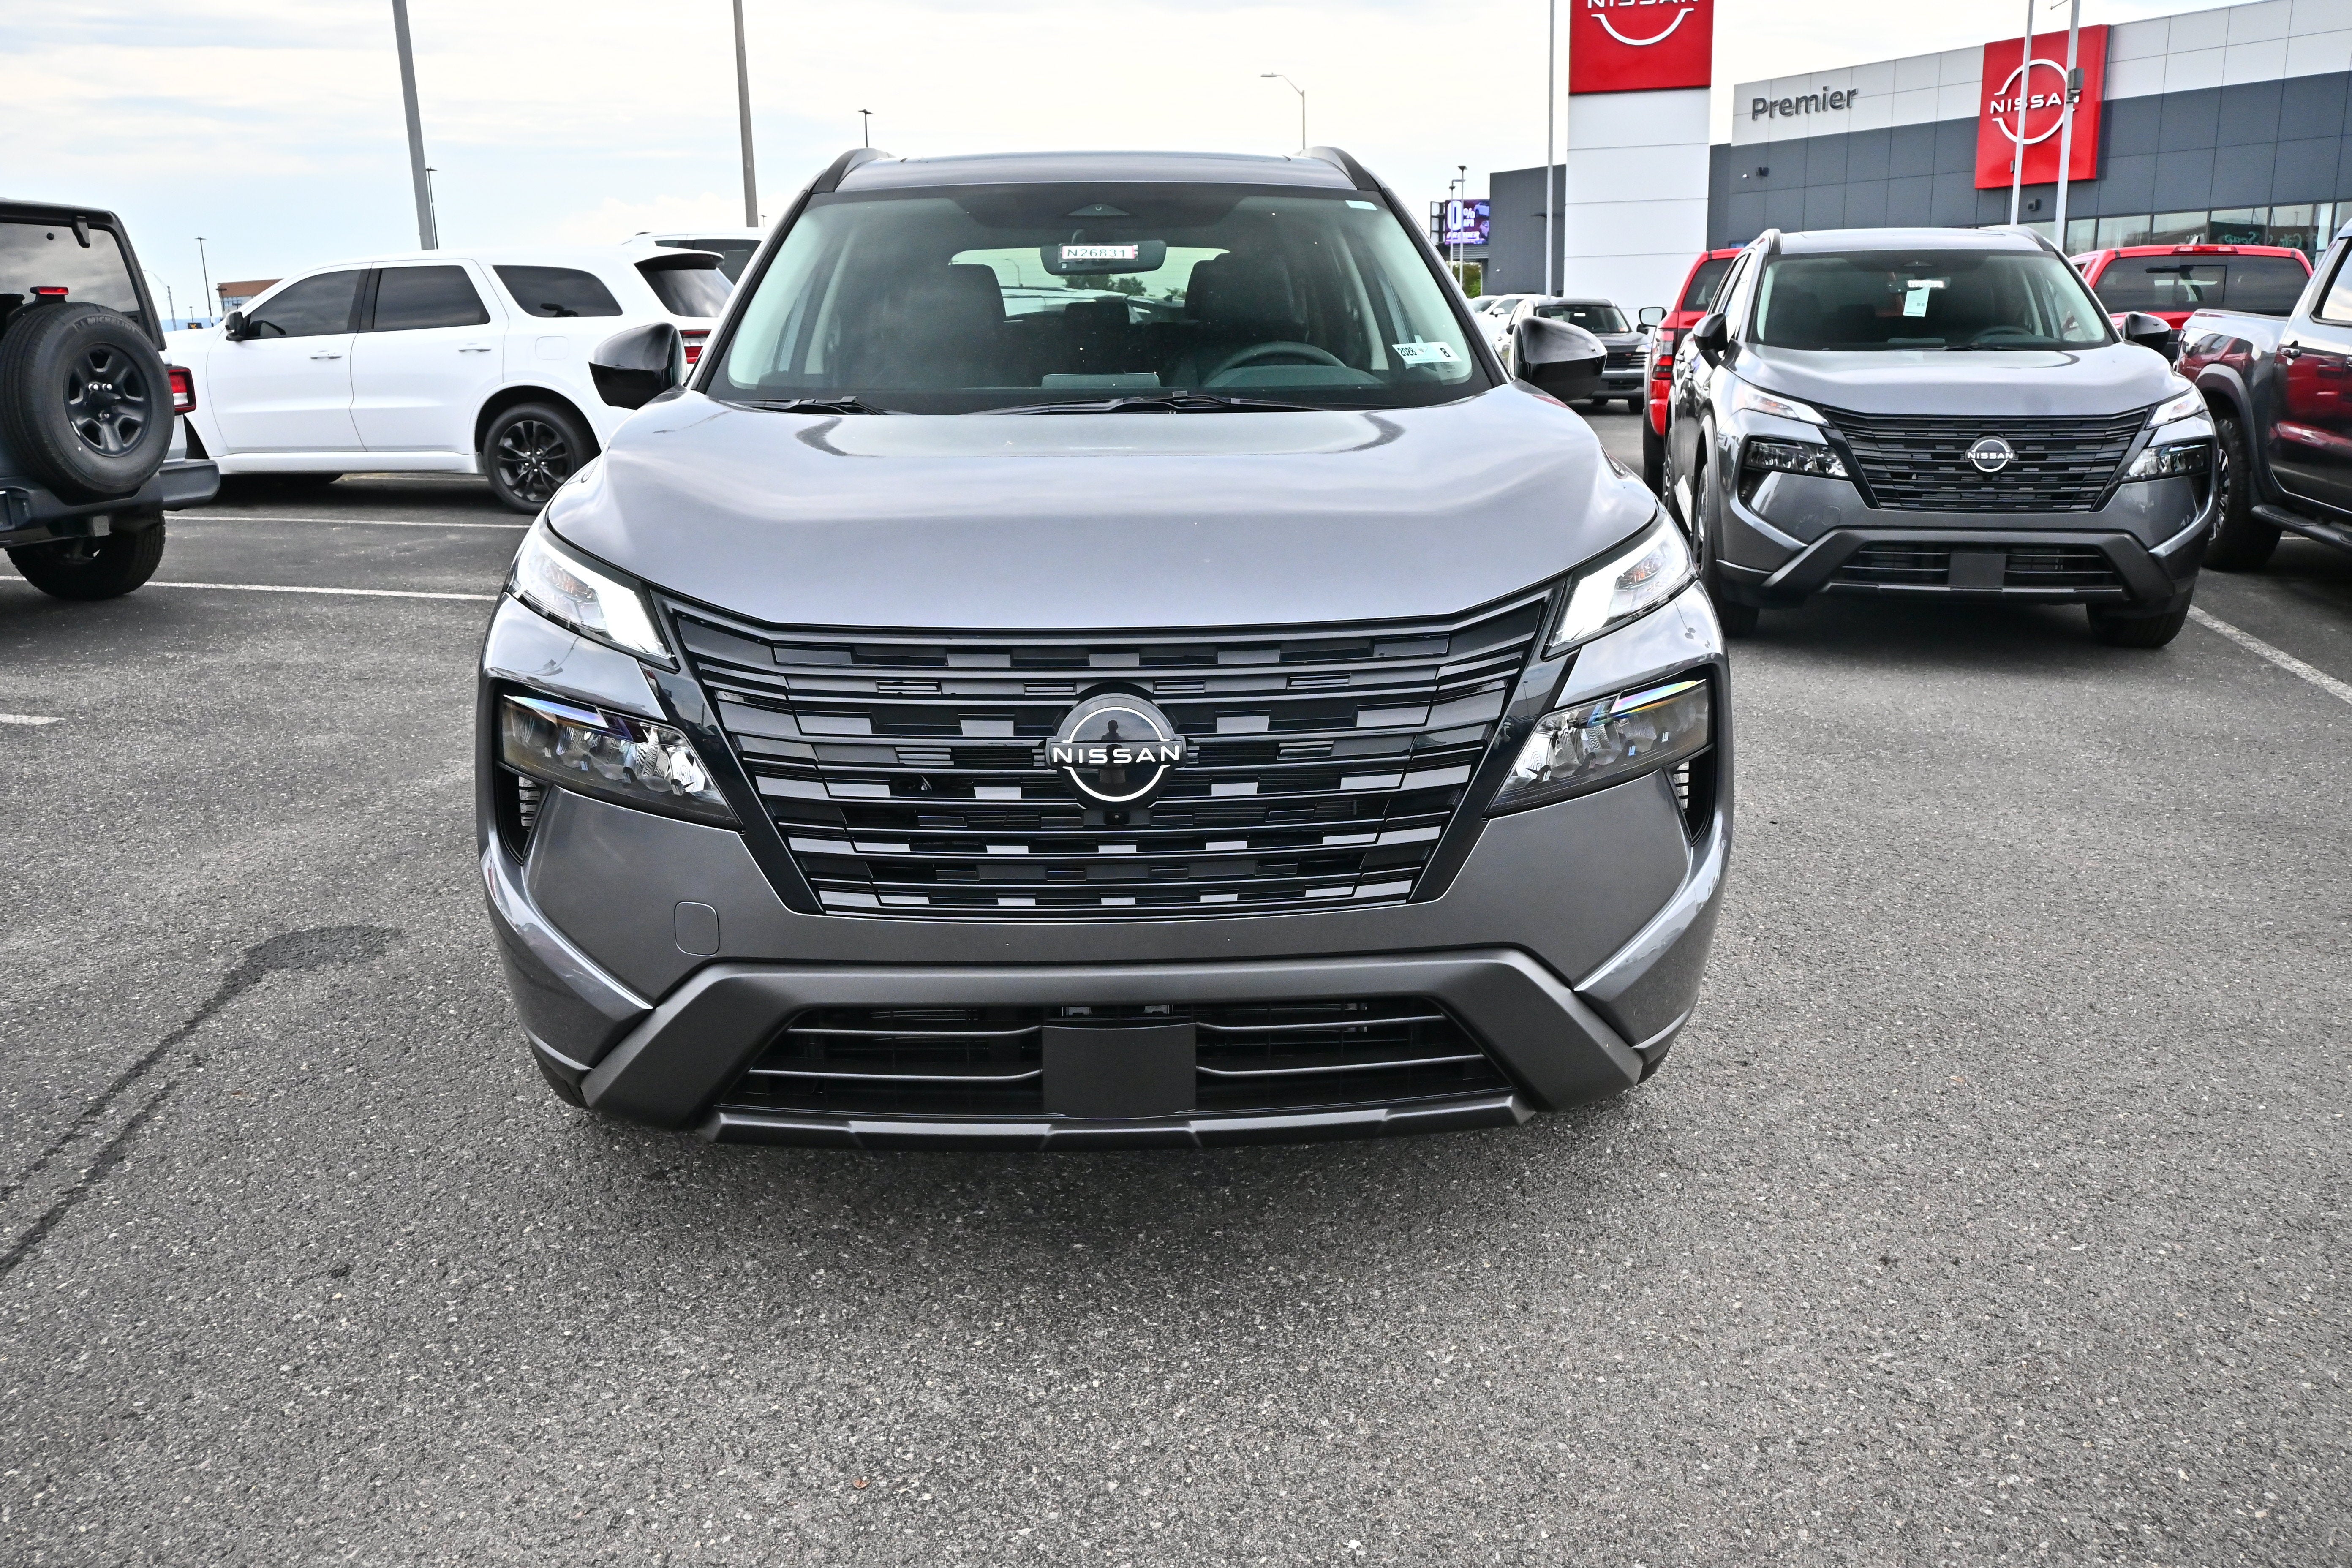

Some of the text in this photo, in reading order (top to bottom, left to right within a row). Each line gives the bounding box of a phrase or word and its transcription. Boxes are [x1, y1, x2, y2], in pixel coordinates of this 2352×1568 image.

[1752, 86, 1858, 120] Premier
[1990, 92, 2079, 114] NISSA
[1067, 249, 1125, 257] N26831
[1397, 347, 1451, 358] 2028 8
[1053, 745, 1179, 764] NISSAN
